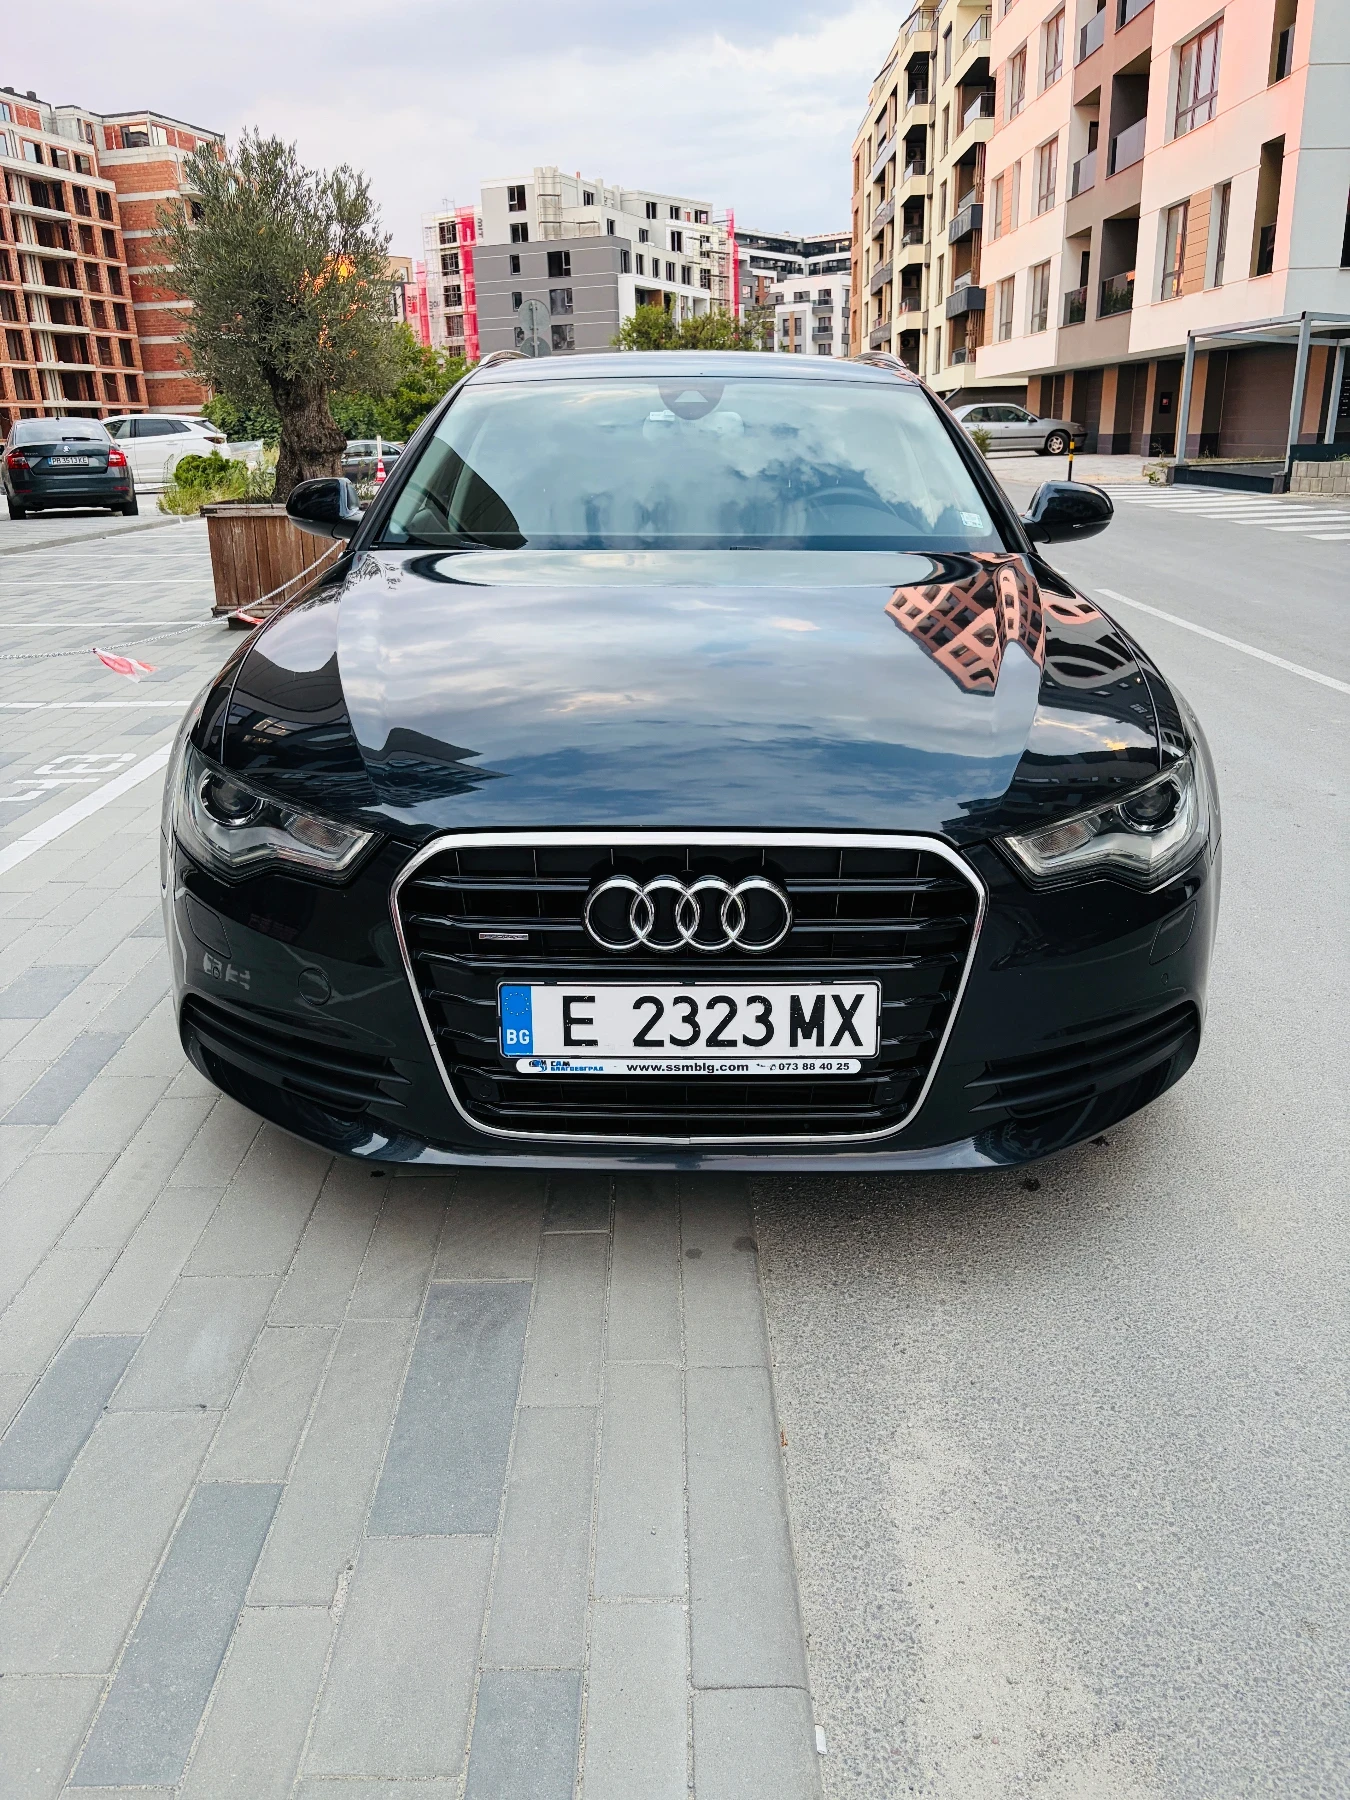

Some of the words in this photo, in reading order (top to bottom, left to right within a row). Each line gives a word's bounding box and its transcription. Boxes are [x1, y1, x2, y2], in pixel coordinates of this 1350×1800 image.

[563, 996, 599, 1047] E
[633, 995, 774, 1047] 2323
[789, 994, 864, 1047] MX
[506, 1029, 530, 1045] BG
[626, 1062, 749, 1074] www.ssmblg.com
[778, 1062, 798, 1071] 073
[802, 1062, 816, 1071] 88
[819, 1062, 833, 1071] 40
[836, 1062, 850, 1071] 25
